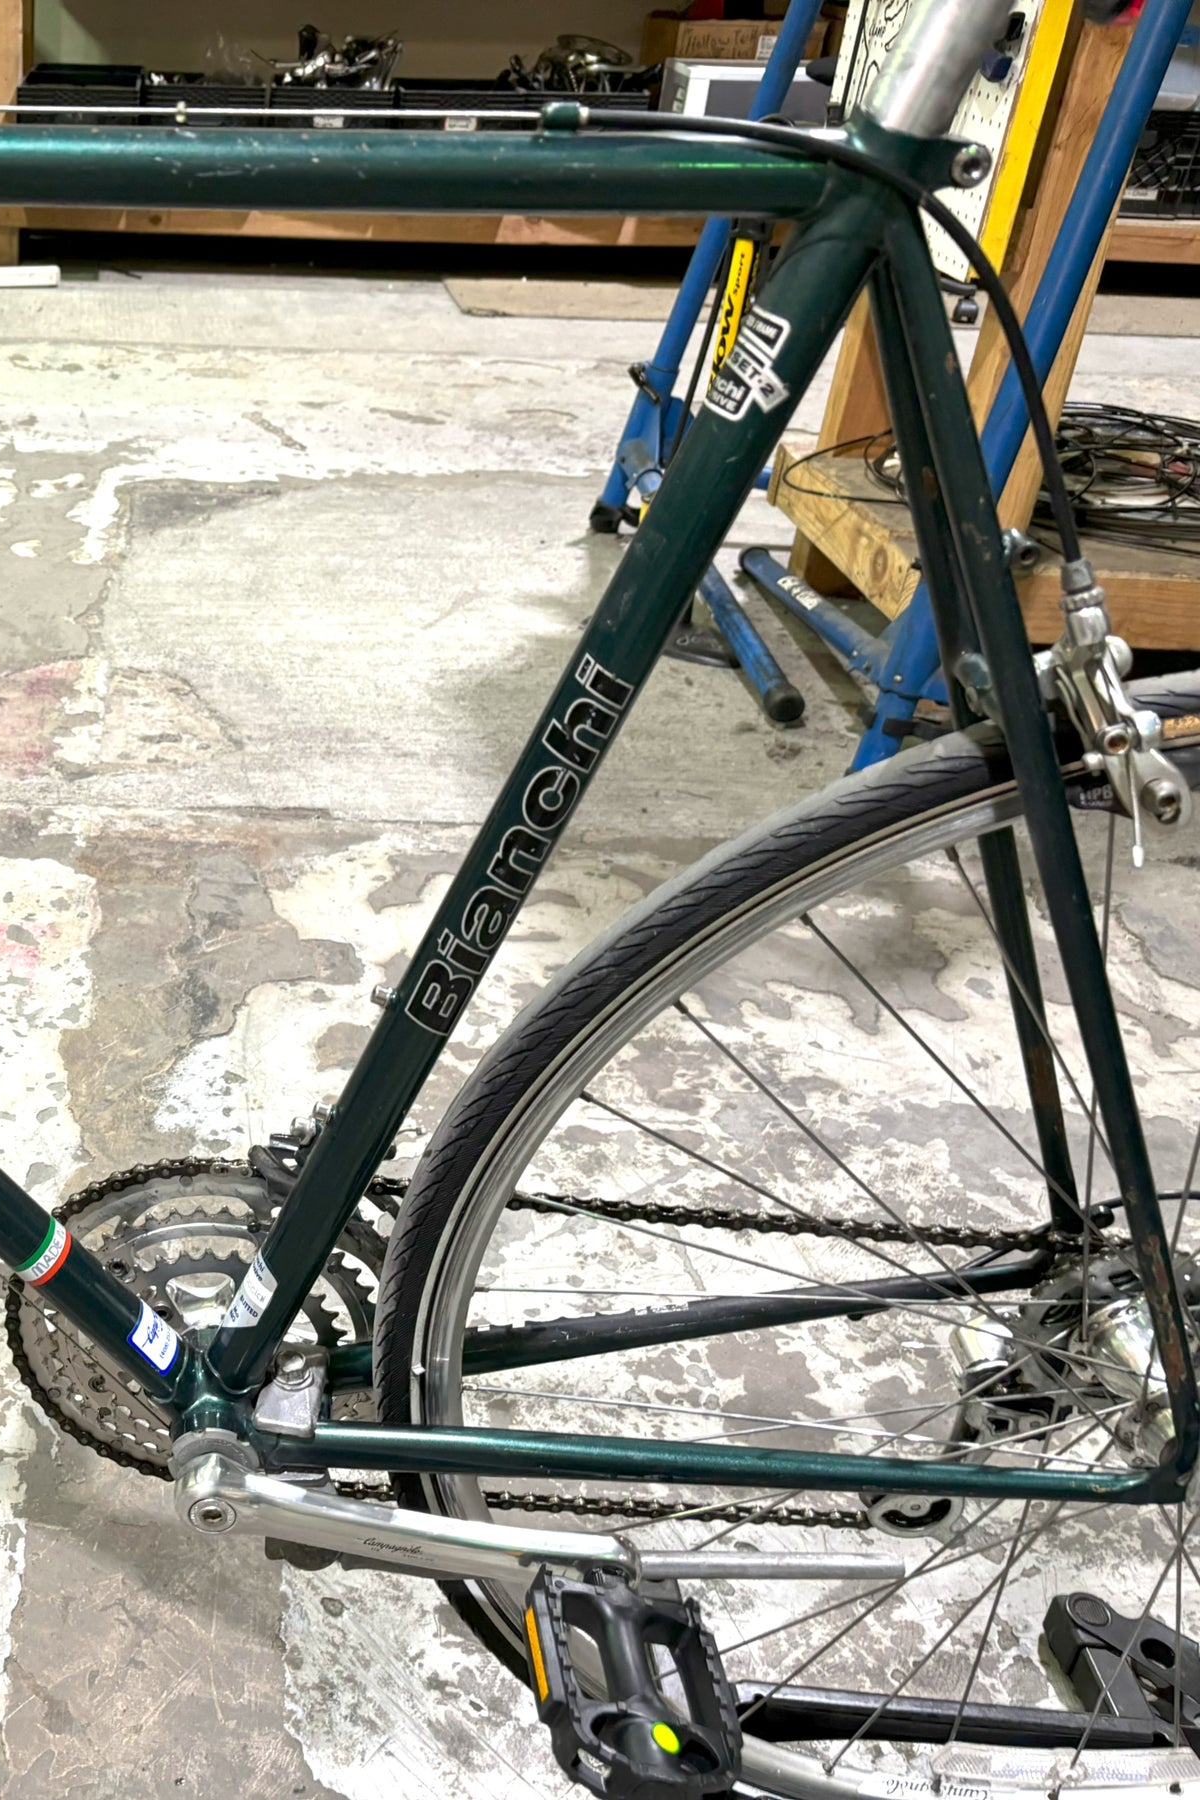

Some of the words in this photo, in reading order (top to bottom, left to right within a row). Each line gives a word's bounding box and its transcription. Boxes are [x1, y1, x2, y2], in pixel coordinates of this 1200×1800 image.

[405, 653, 634, 1037] Bianchi
[31, 1238, 64, 1278] MADE
[885, 1778, 988, 1800] Campgnolo
